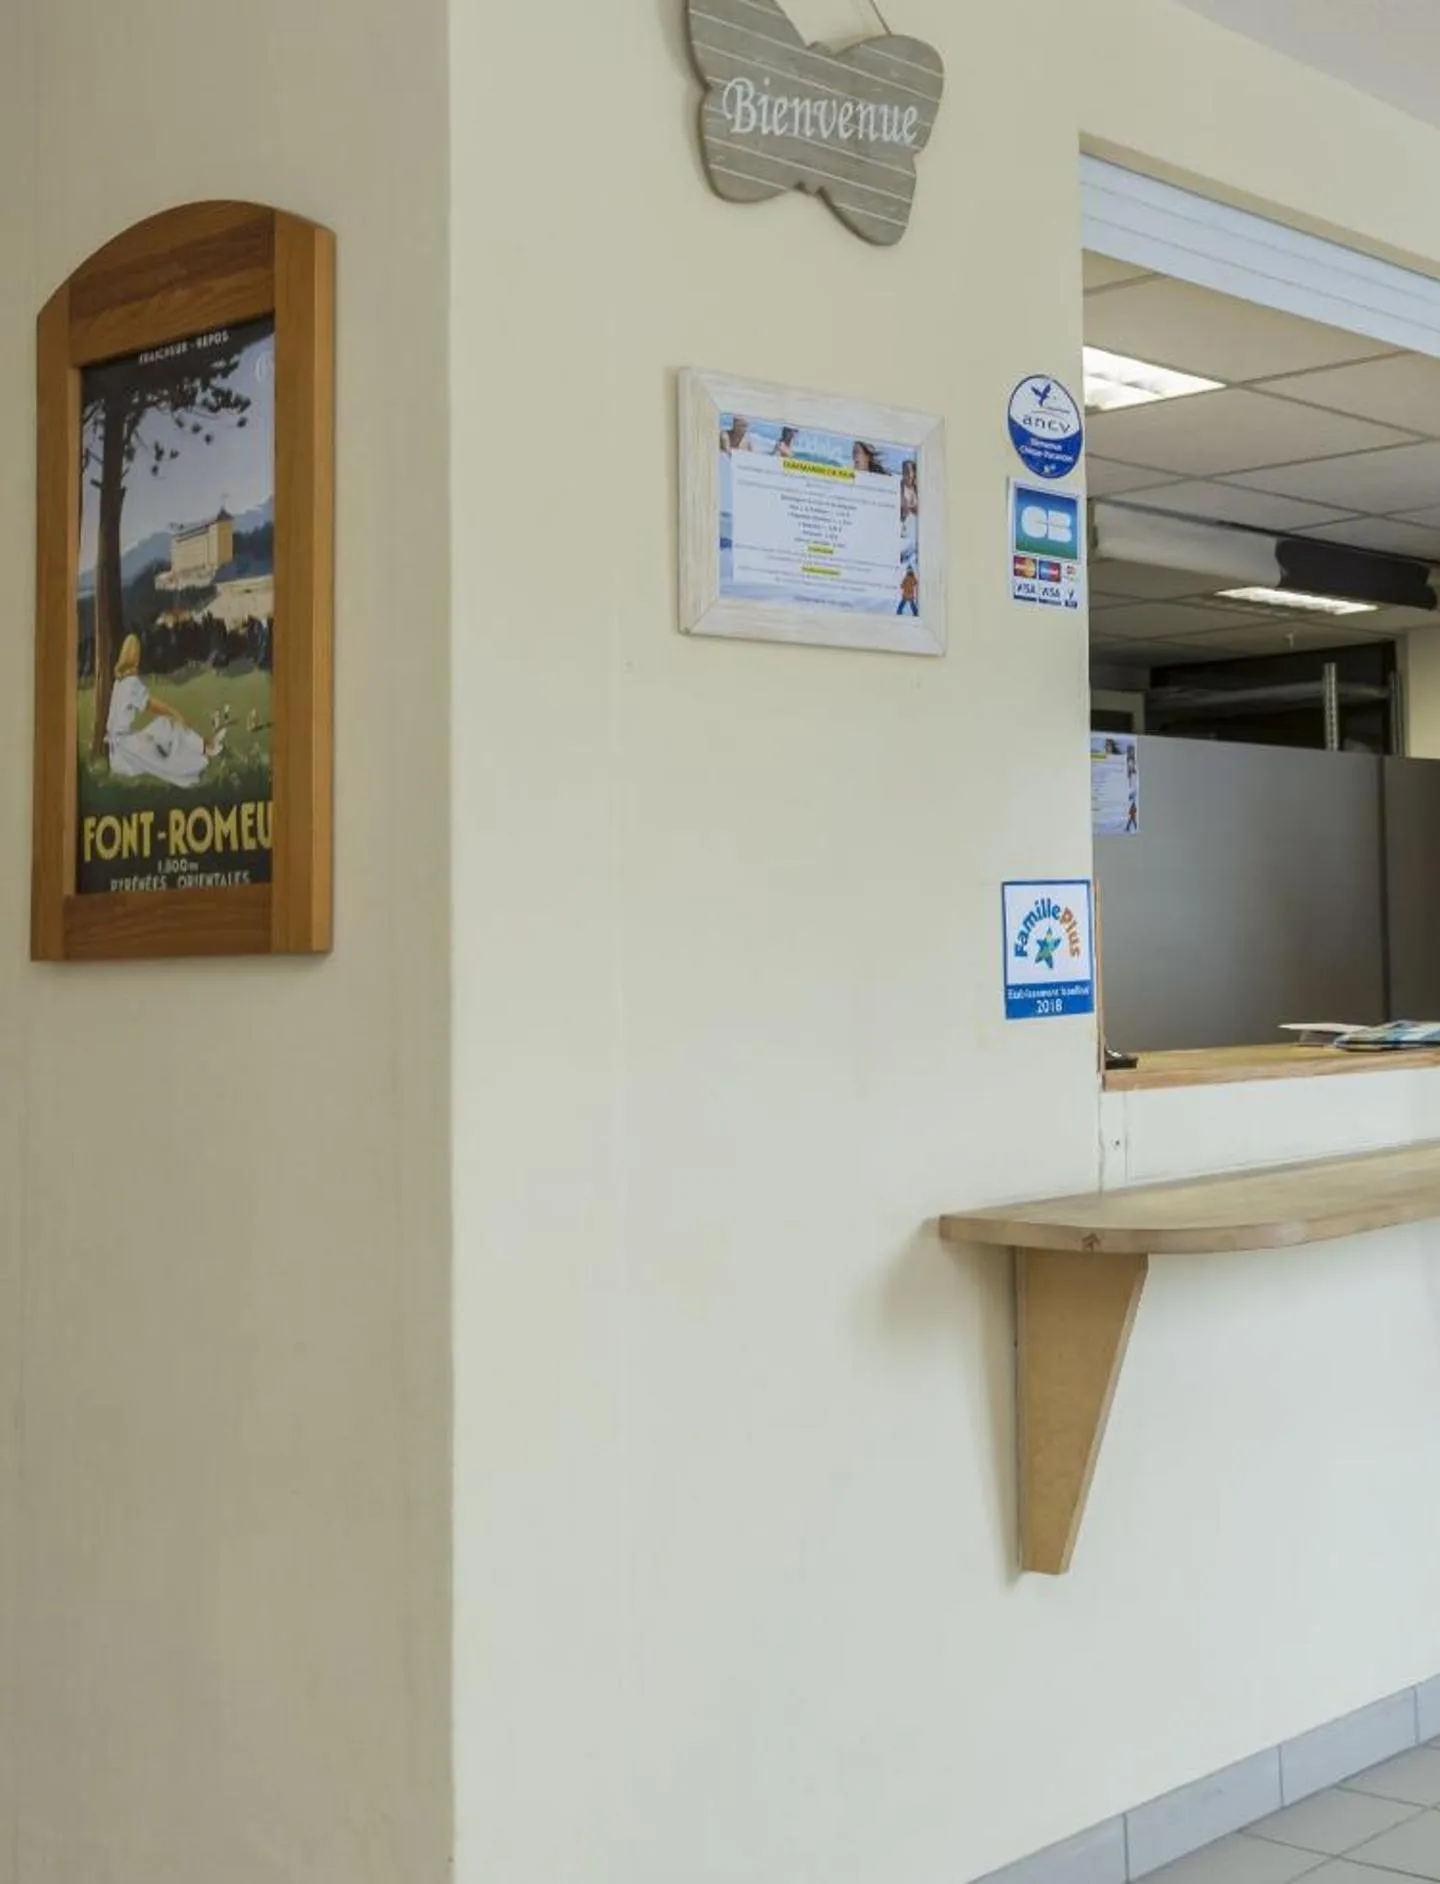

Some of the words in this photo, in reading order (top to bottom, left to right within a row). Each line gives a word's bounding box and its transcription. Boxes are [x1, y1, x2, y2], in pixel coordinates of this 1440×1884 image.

[722, 76, 919, 147] Bienvenue
[1012, 897, 1061, 958] Famille
[1035, 997, 1064, 1014] 2018
